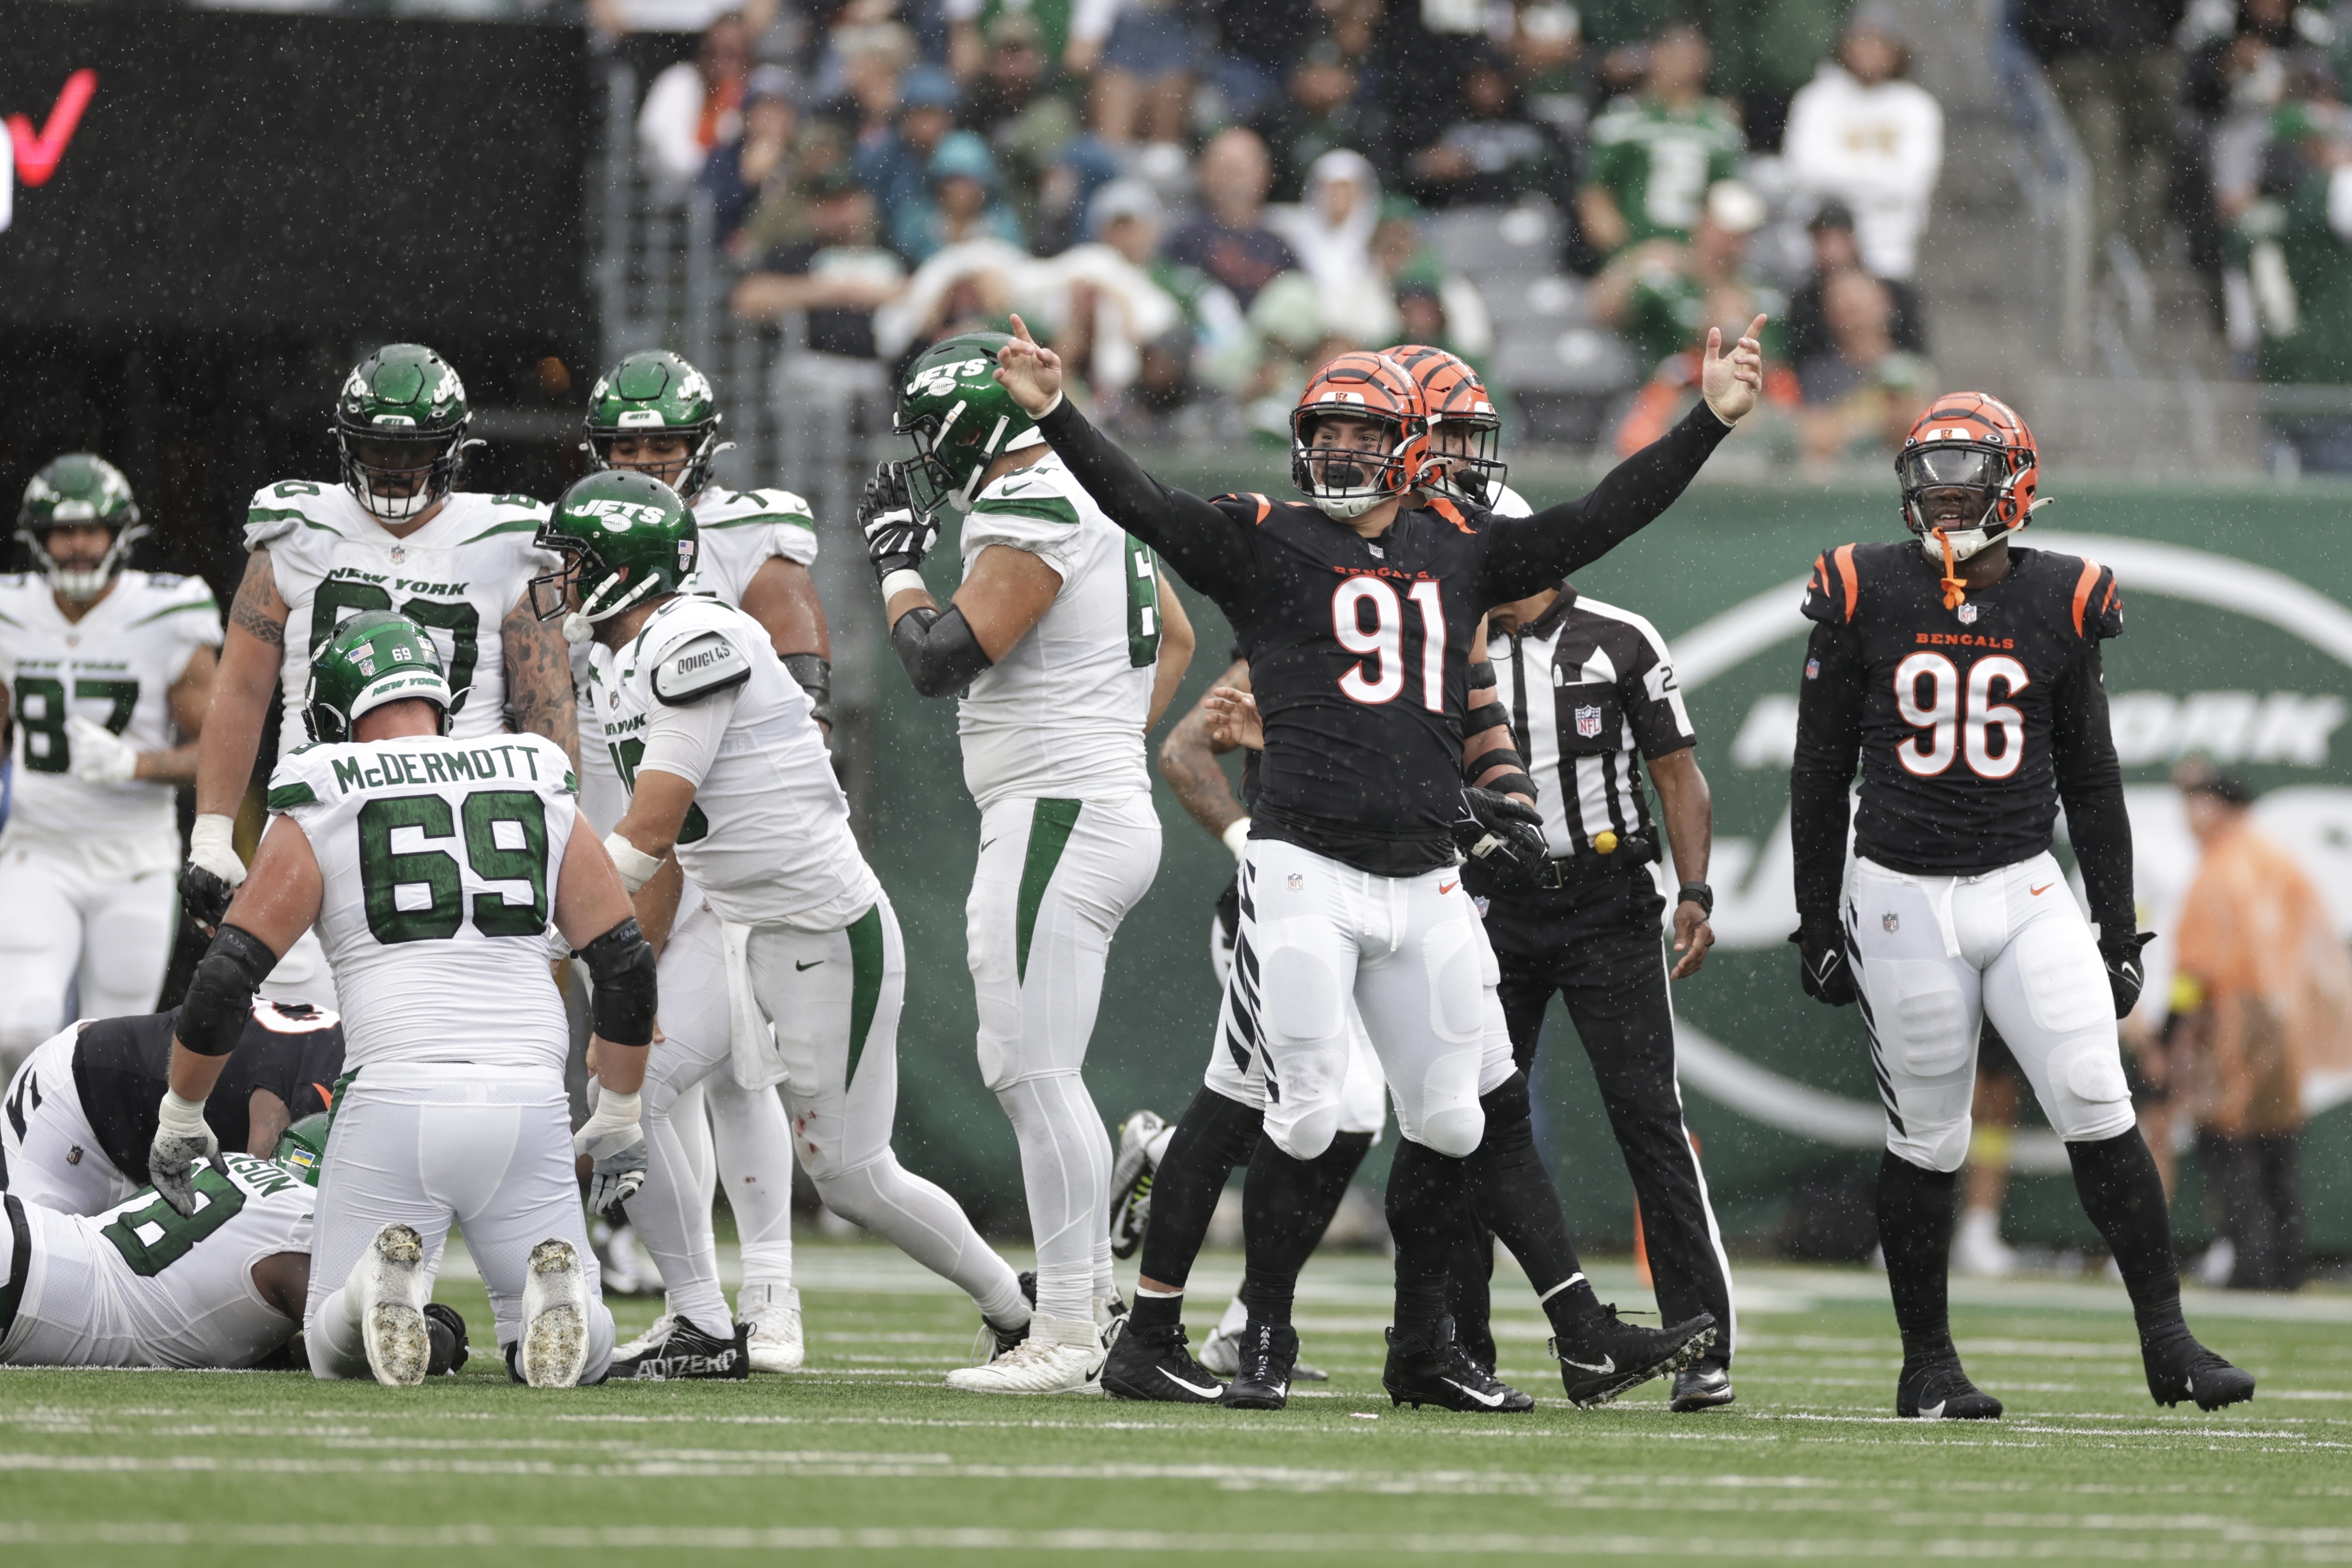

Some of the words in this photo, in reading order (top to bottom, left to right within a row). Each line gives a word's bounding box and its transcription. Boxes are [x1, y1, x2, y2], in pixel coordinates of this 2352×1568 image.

[906, 359, 988, 395] JETS
[573, 499, 666, 524] JETS
[328, 567, 390, 584] NEW
[395, 579, 470, 596] YORK
[392, 647, 412, 662] 69
[1331, 575, 1447, 713] 91
[1916, 633, 2014, 649] BENGALS
[372, 679, 406, 696] NEW
[410, 677, 442, 688] YORK
[1660, 664, 1679, 693] 2
[15, 677, 139, 772] 87
[1579, 719, 1599, 734] NFL
[1893, 650, 2030, 779] 96
[331, 745, 539, 795] McDERMOTT
[357, 790, 550, 945] 69
